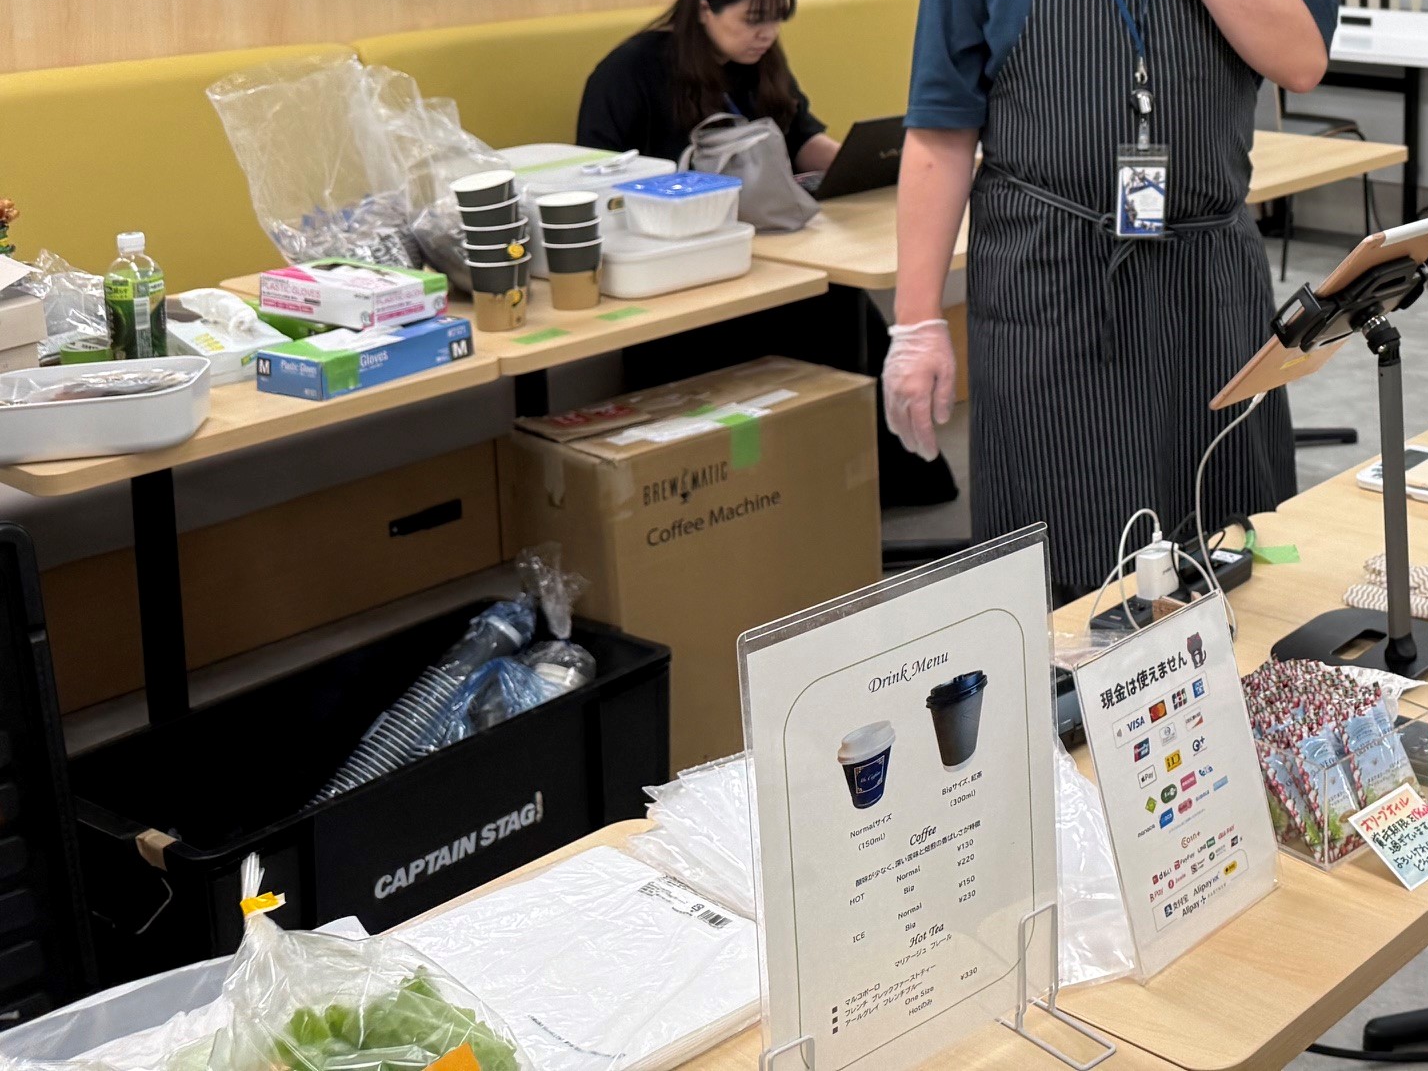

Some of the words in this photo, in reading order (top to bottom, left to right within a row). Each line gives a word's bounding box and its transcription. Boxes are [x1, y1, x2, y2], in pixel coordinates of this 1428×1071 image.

[259, 359, 270, 375] M
[451, 339, 468, 359] M
[647, 515, 705, 547] Coffee
[709, 489, 781, 527] Machine
[868, 663, 911, 693] Drink
[911, 652, 949, 677] Menu
[1100, 651, 1187, 709] 現金は使えません
[1127, 716, 1145, 732] VISA
[1360, 796, 1410, 832] オリーブオイル
[909, 825, 937, 846] Coffee
[374, 830, 477, 900] CAPTAIN
[849, 893, 865, 906] HOT
[896, 865, 921, 883] Normal
[957, 838, 974, 852] ¥130
[957, 853, 975, 867] ¥220
[897, 902, 922, 920] Normal
[958, 875, 976, 888] ¥150
[958, 889, 976, 903] ¥230
[909, 932, 927, 948] Hot
[928, 922, 945, 937] Tea
[904, 994, 919, 1006] One
[919, 985, 935, 999] Size
[960, 966, 978, 980] ¥330
